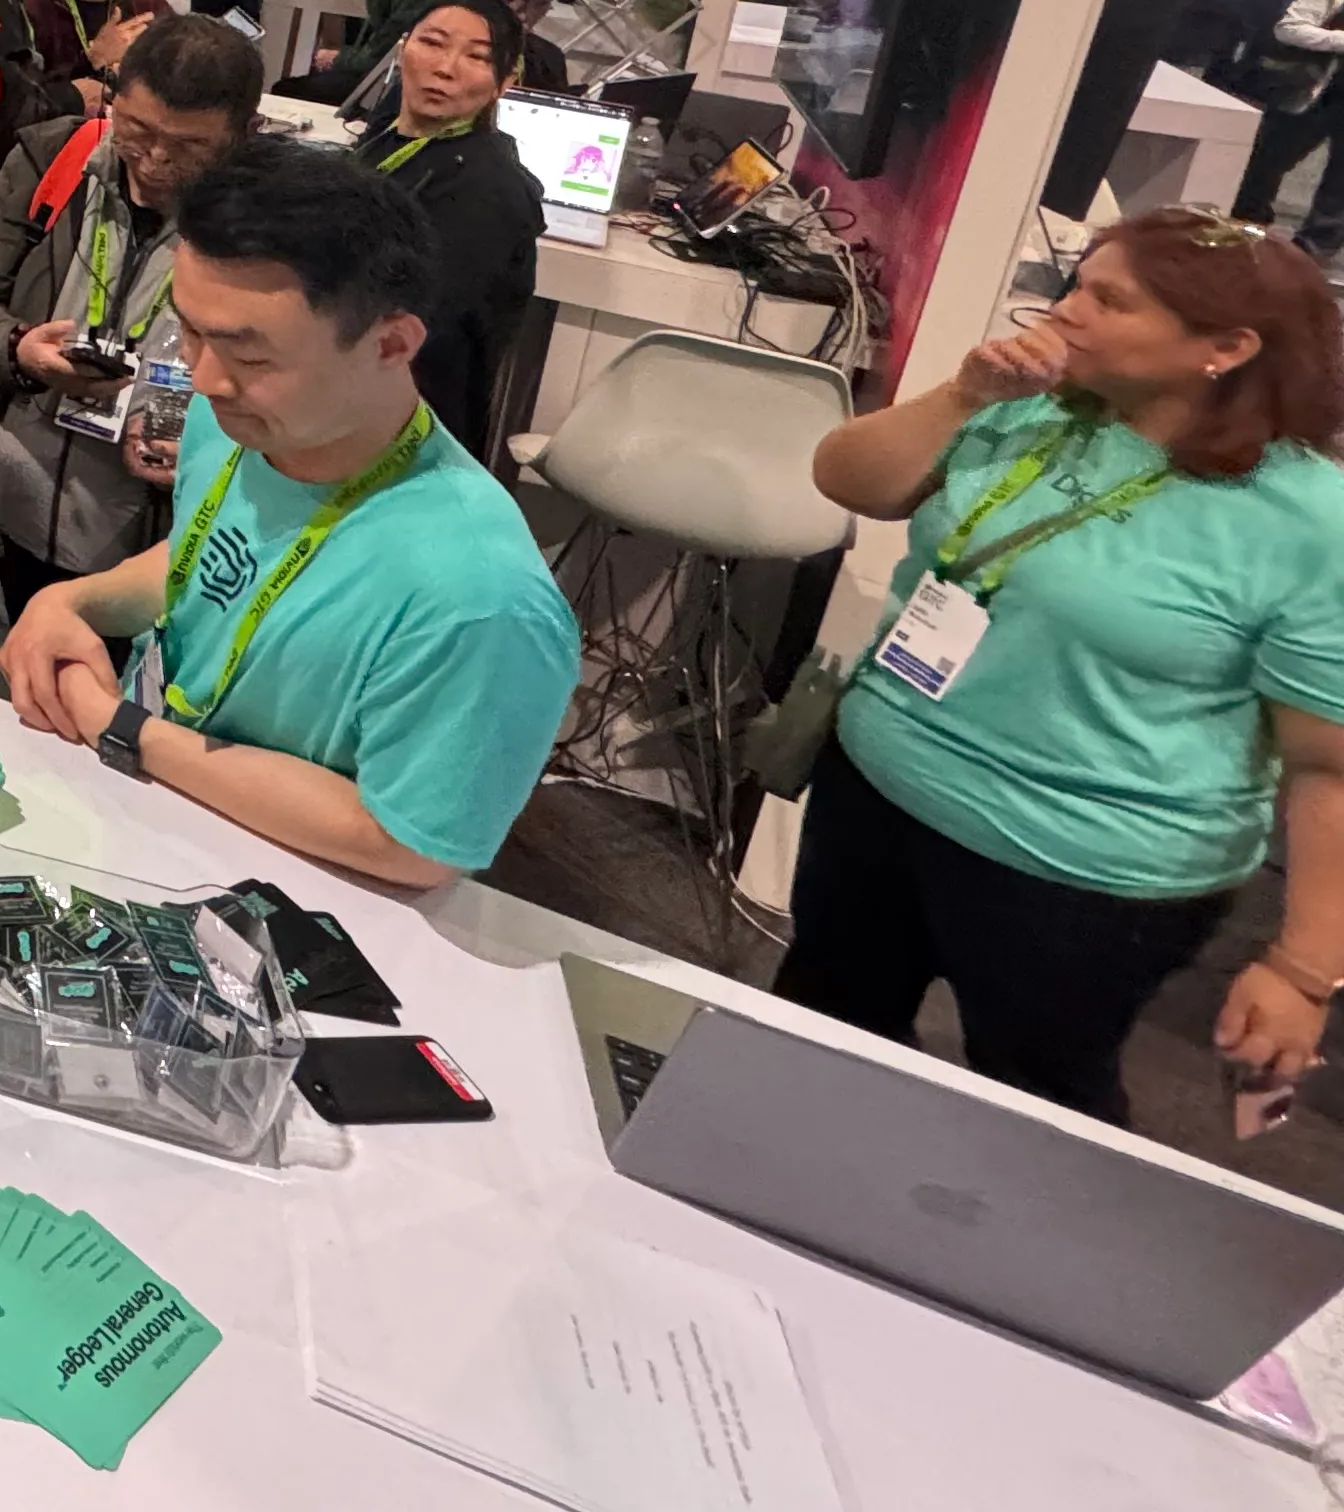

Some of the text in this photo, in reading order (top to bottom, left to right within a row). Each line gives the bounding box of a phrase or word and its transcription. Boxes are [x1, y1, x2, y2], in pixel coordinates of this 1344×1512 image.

[194, 499, 216, 531] GTC
[102, 1281, 164, 1340] General
[94, 1299, 188, 1389] Autonomous
